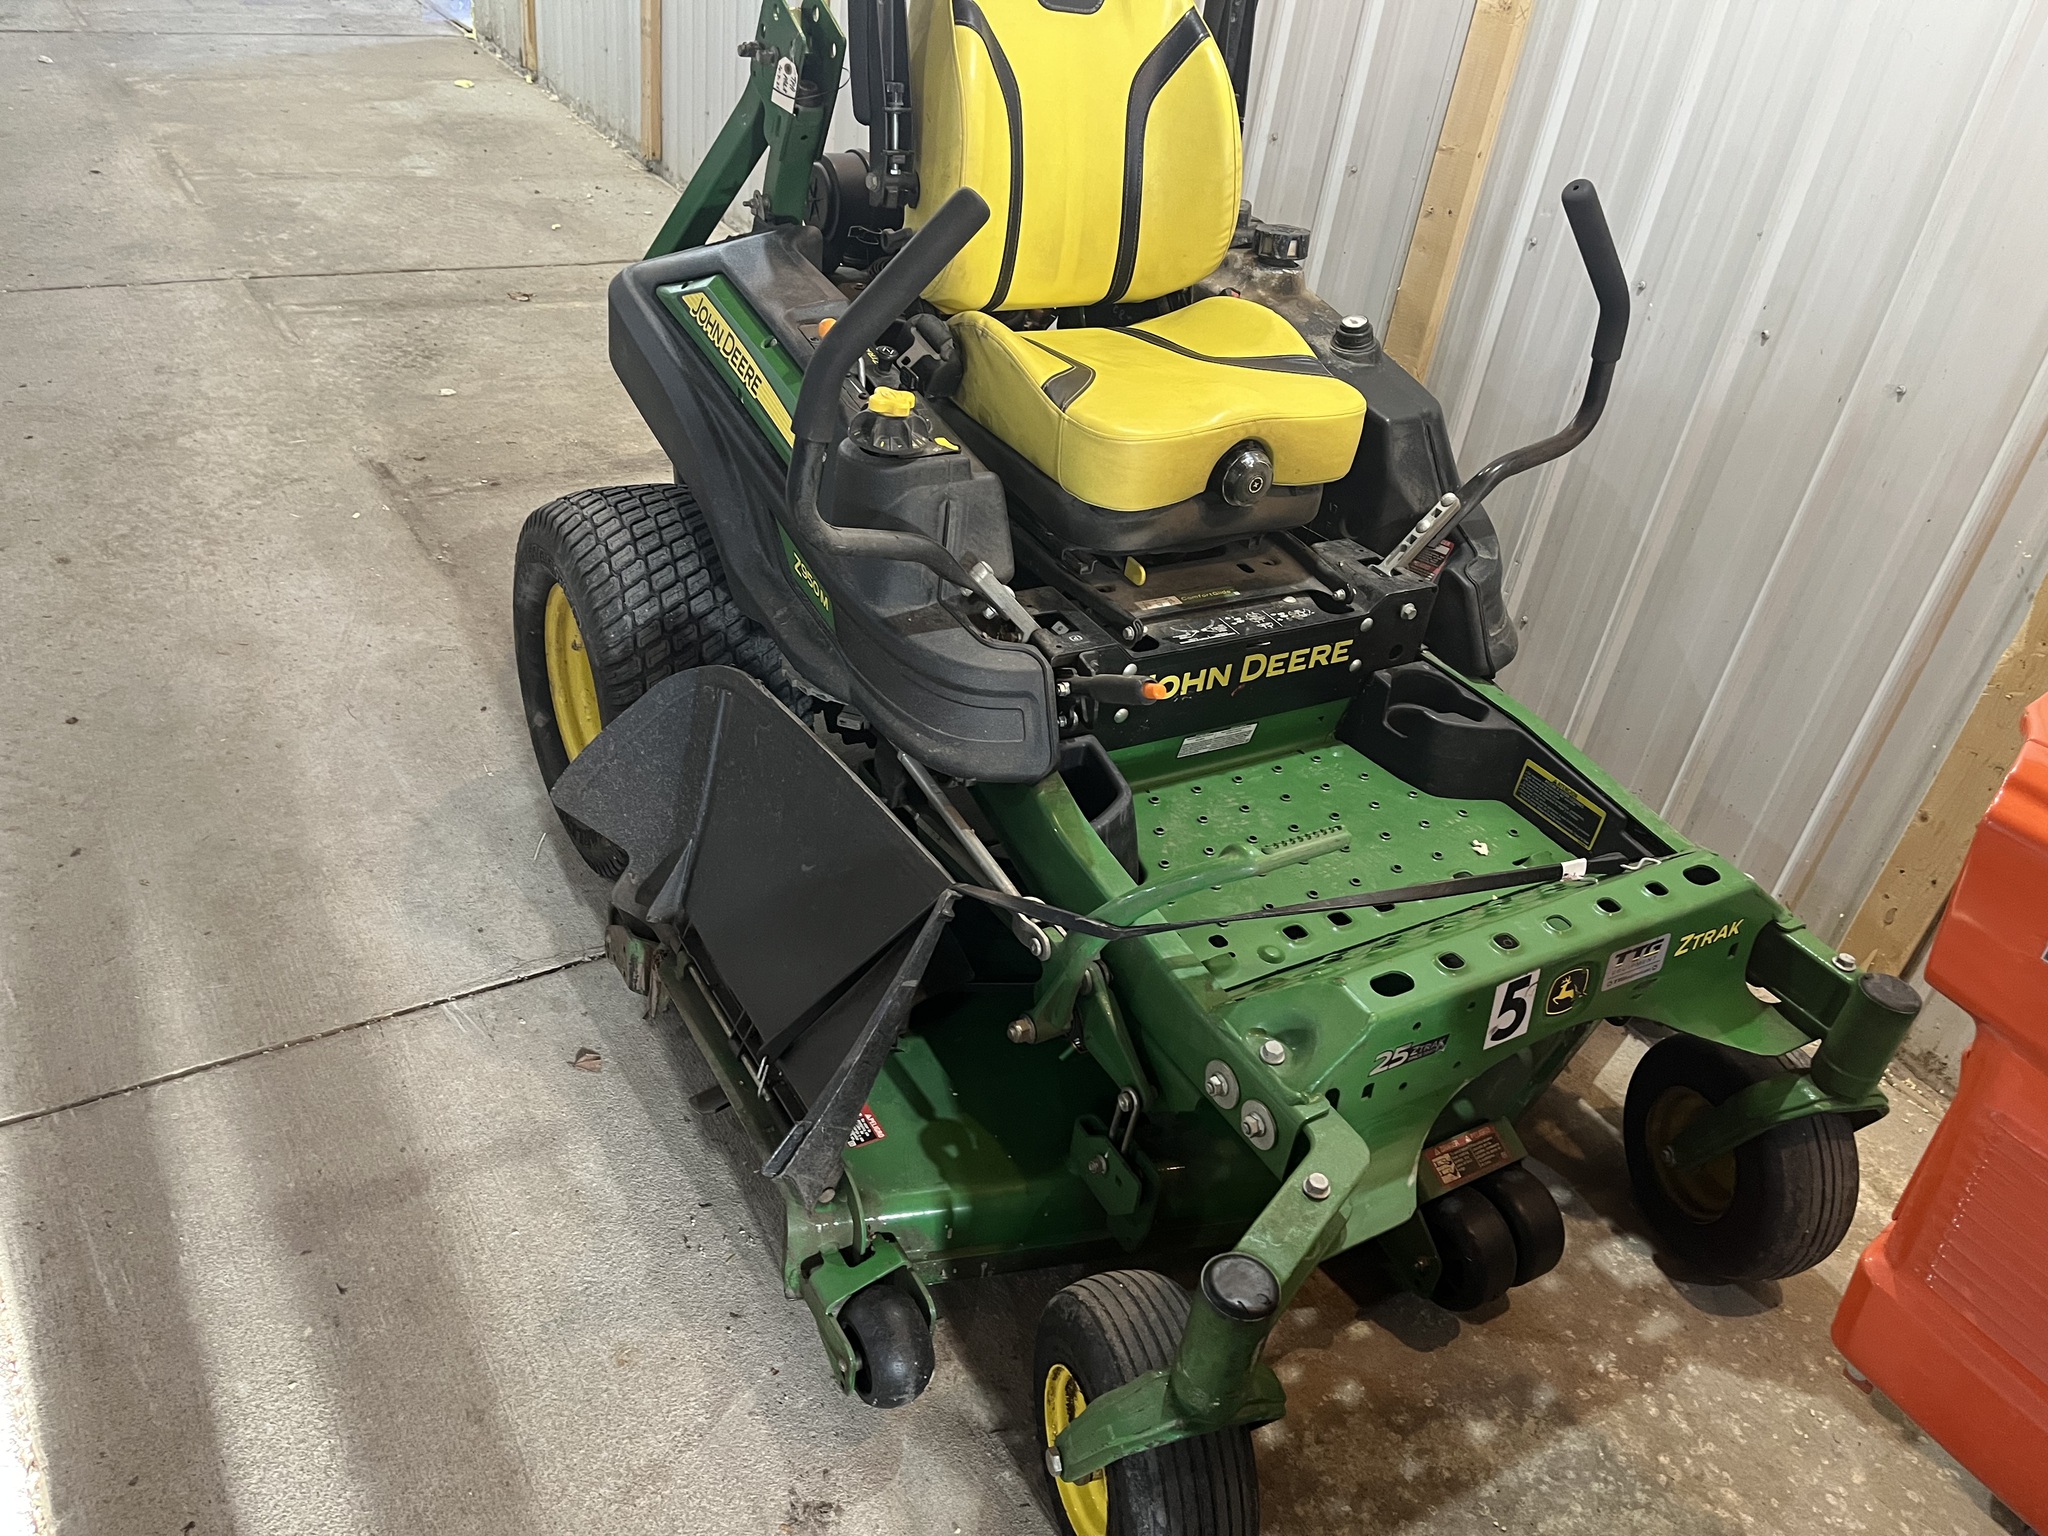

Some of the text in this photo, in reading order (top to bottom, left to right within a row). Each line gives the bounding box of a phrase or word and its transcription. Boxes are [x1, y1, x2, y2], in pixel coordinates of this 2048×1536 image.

[691, 297, 763, 396] JOHN DEERE
[793, 551, 830, 612] Z950M
[1150, 639, 1354, 700] OHN DEERE
[1614, 938, 1665, 968] TTG
[1674, 918, 1745, 957] ZTRAK
[1490, 974, 1532, 1041] 5
[1368, 1042, 1413, 1077] 25
